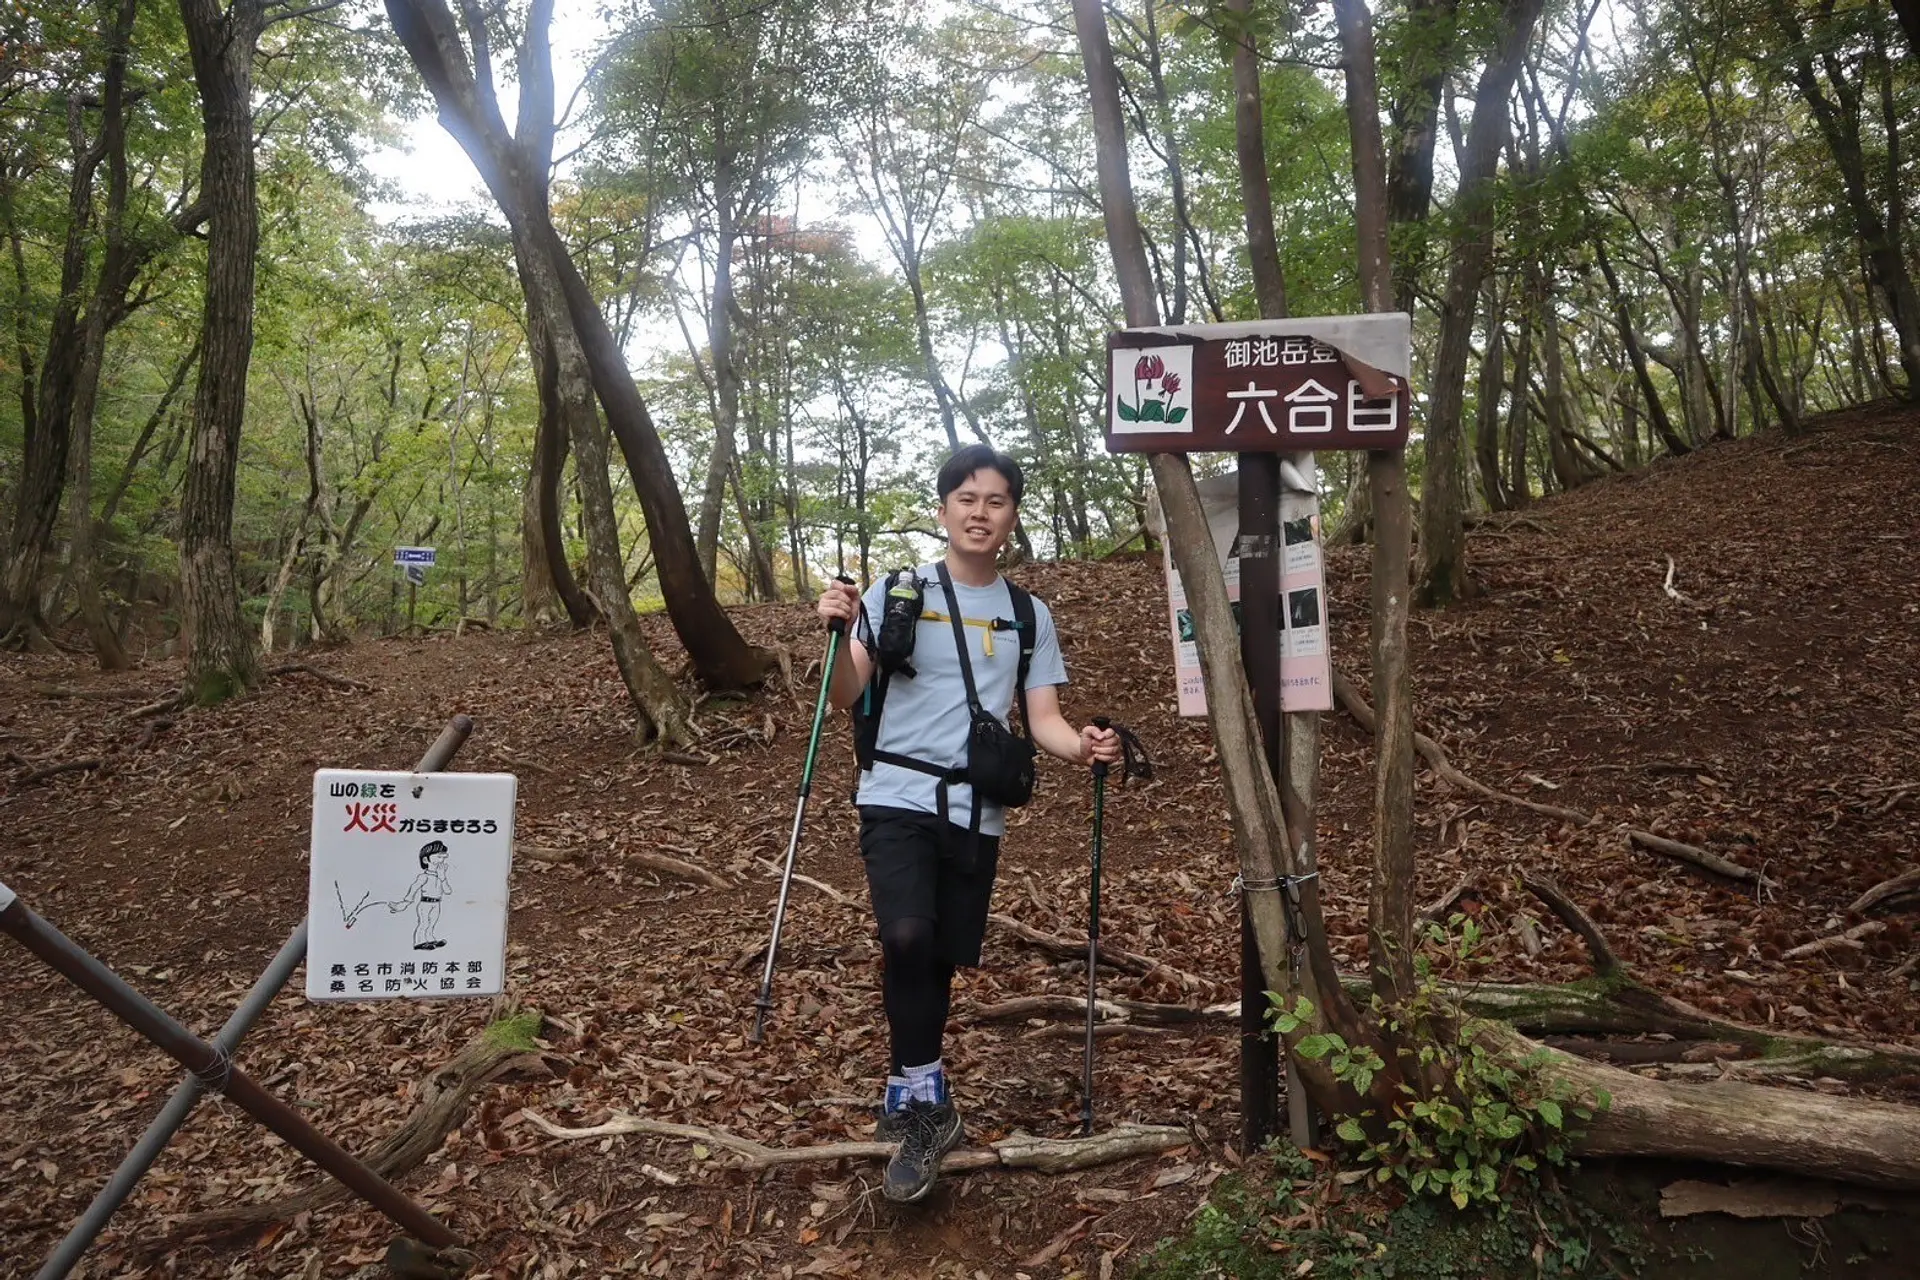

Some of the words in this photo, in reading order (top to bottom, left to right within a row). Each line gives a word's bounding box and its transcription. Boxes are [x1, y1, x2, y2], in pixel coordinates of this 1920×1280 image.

[1225, 378, 1398, 435] 六合目
[330, 782, 396, 798] 山の緑を
[343, 802, 498, 834] 火災からまもろう
[330, 961, 482, 977] 桑名市消防本部
[330, 977, 482, 993] 桑名防火協会
